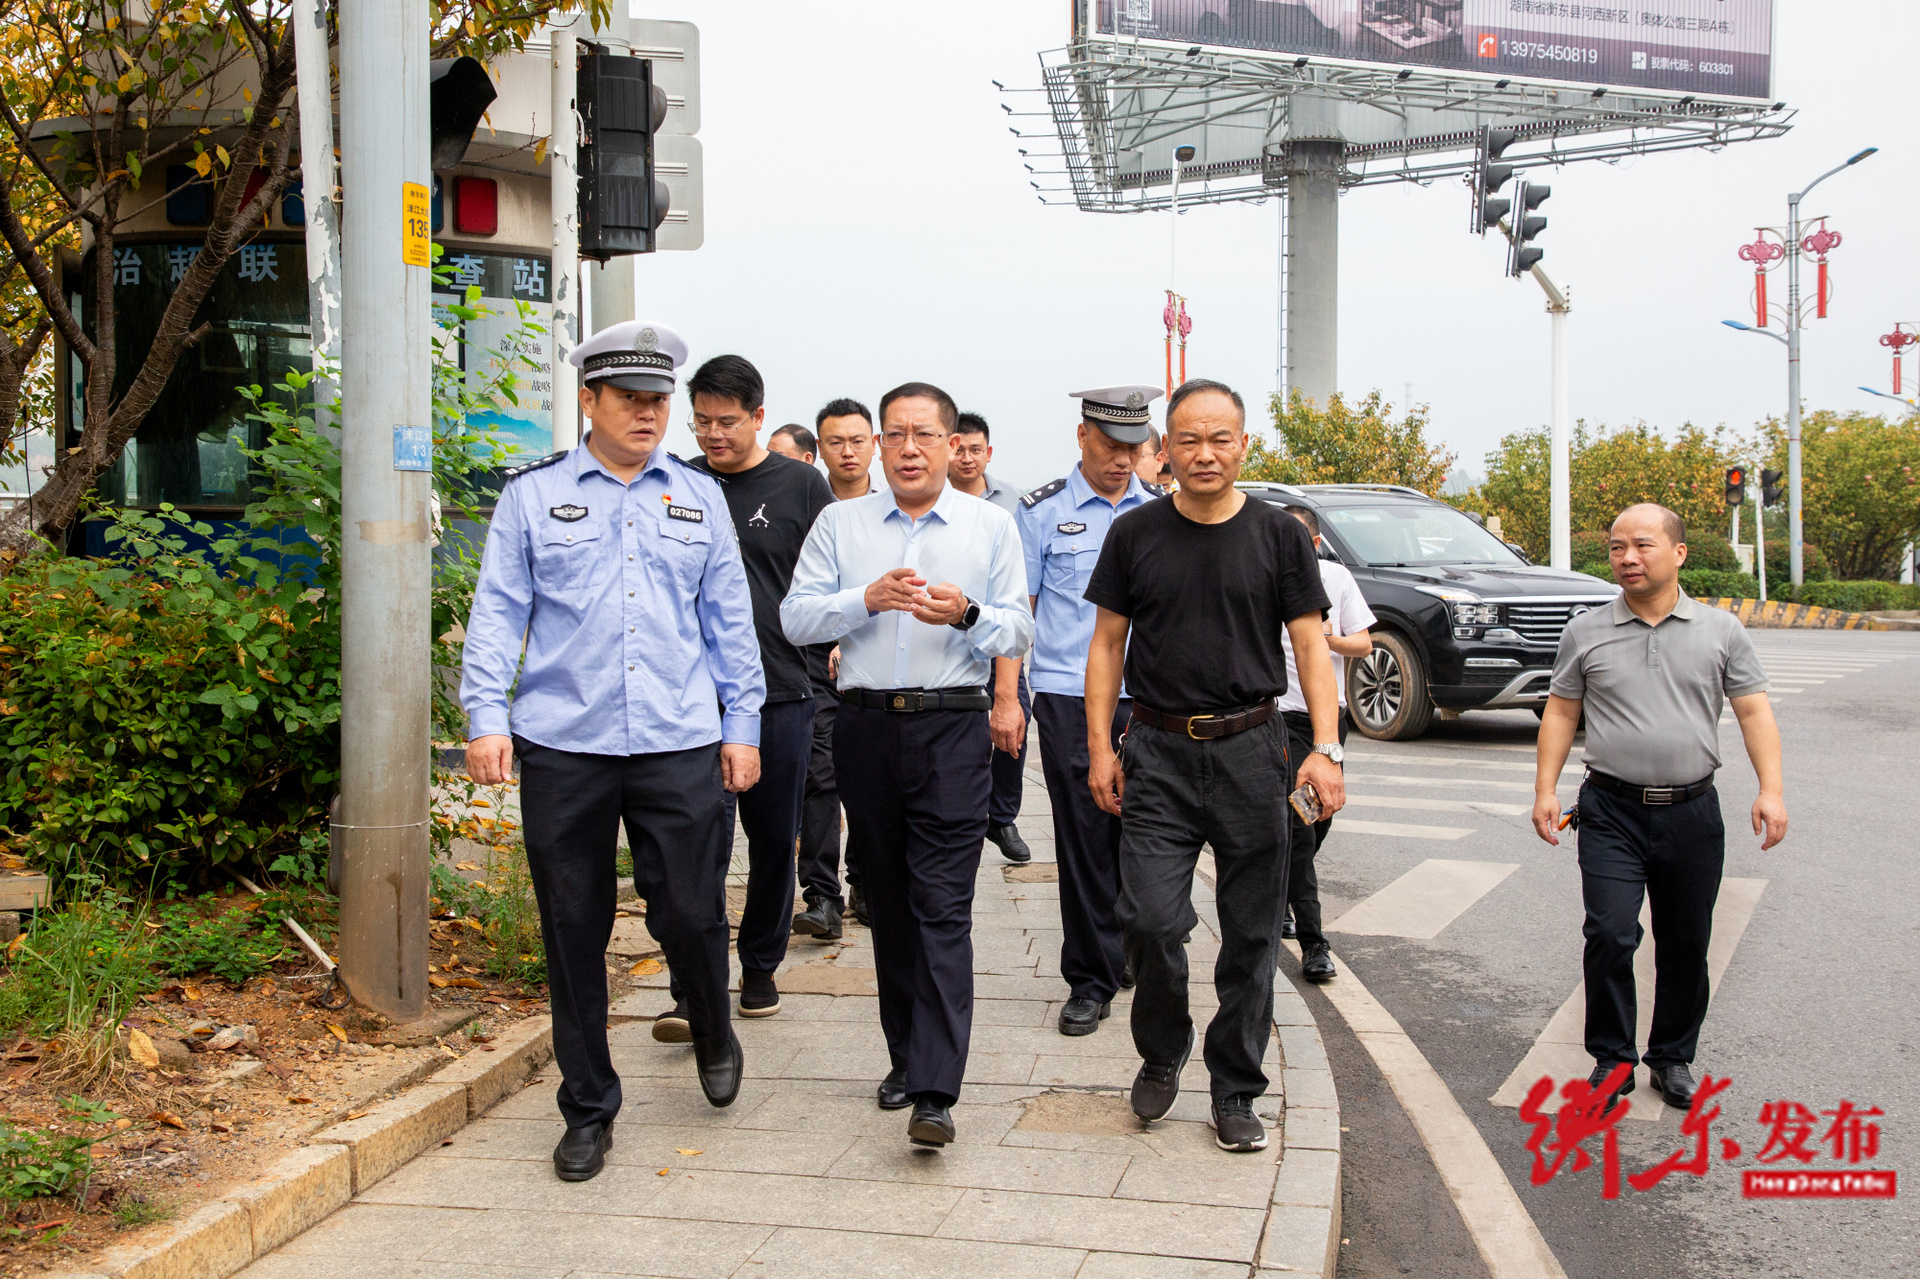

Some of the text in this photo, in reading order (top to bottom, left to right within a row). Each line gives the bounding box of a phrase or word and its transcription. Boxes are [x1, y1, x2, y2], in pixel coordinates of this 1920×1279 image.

[1501, 40, 1598, 64] 13975450819
[408, 217, 429, 240] 135
[669, 507, 701, 520] 027086
